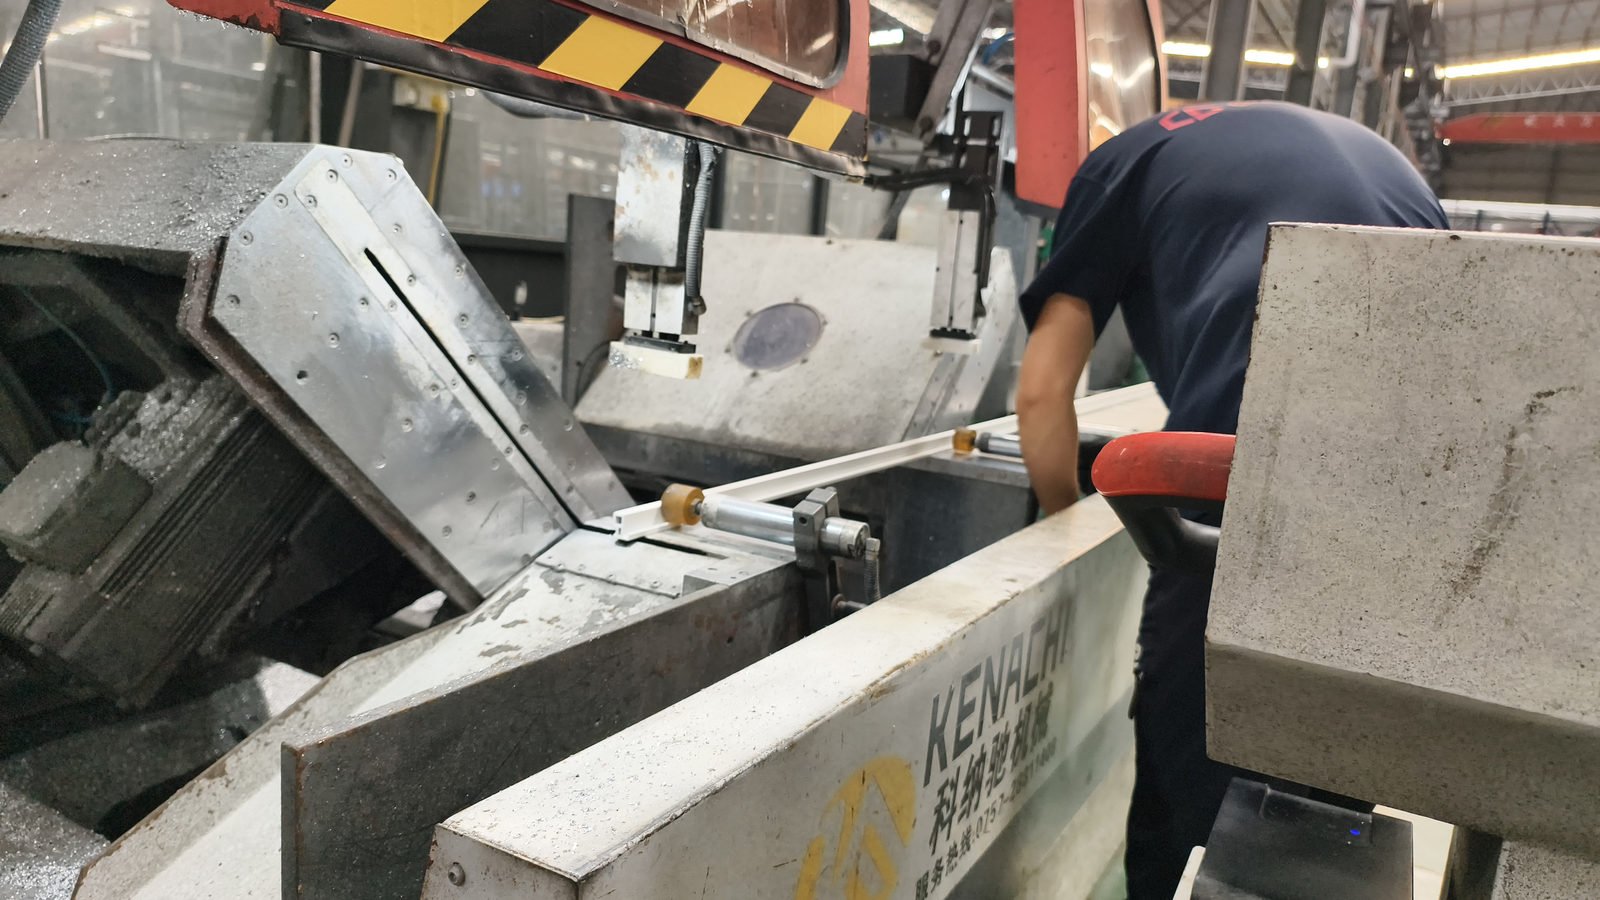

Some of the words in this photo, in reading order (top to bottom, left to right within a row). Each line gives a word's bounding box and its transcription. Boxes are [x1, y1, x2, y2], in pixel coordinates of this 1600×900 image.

[923, 598, 1074, 788] KENACHI
[929, 681, 1054, 856] 科纳驰机械
